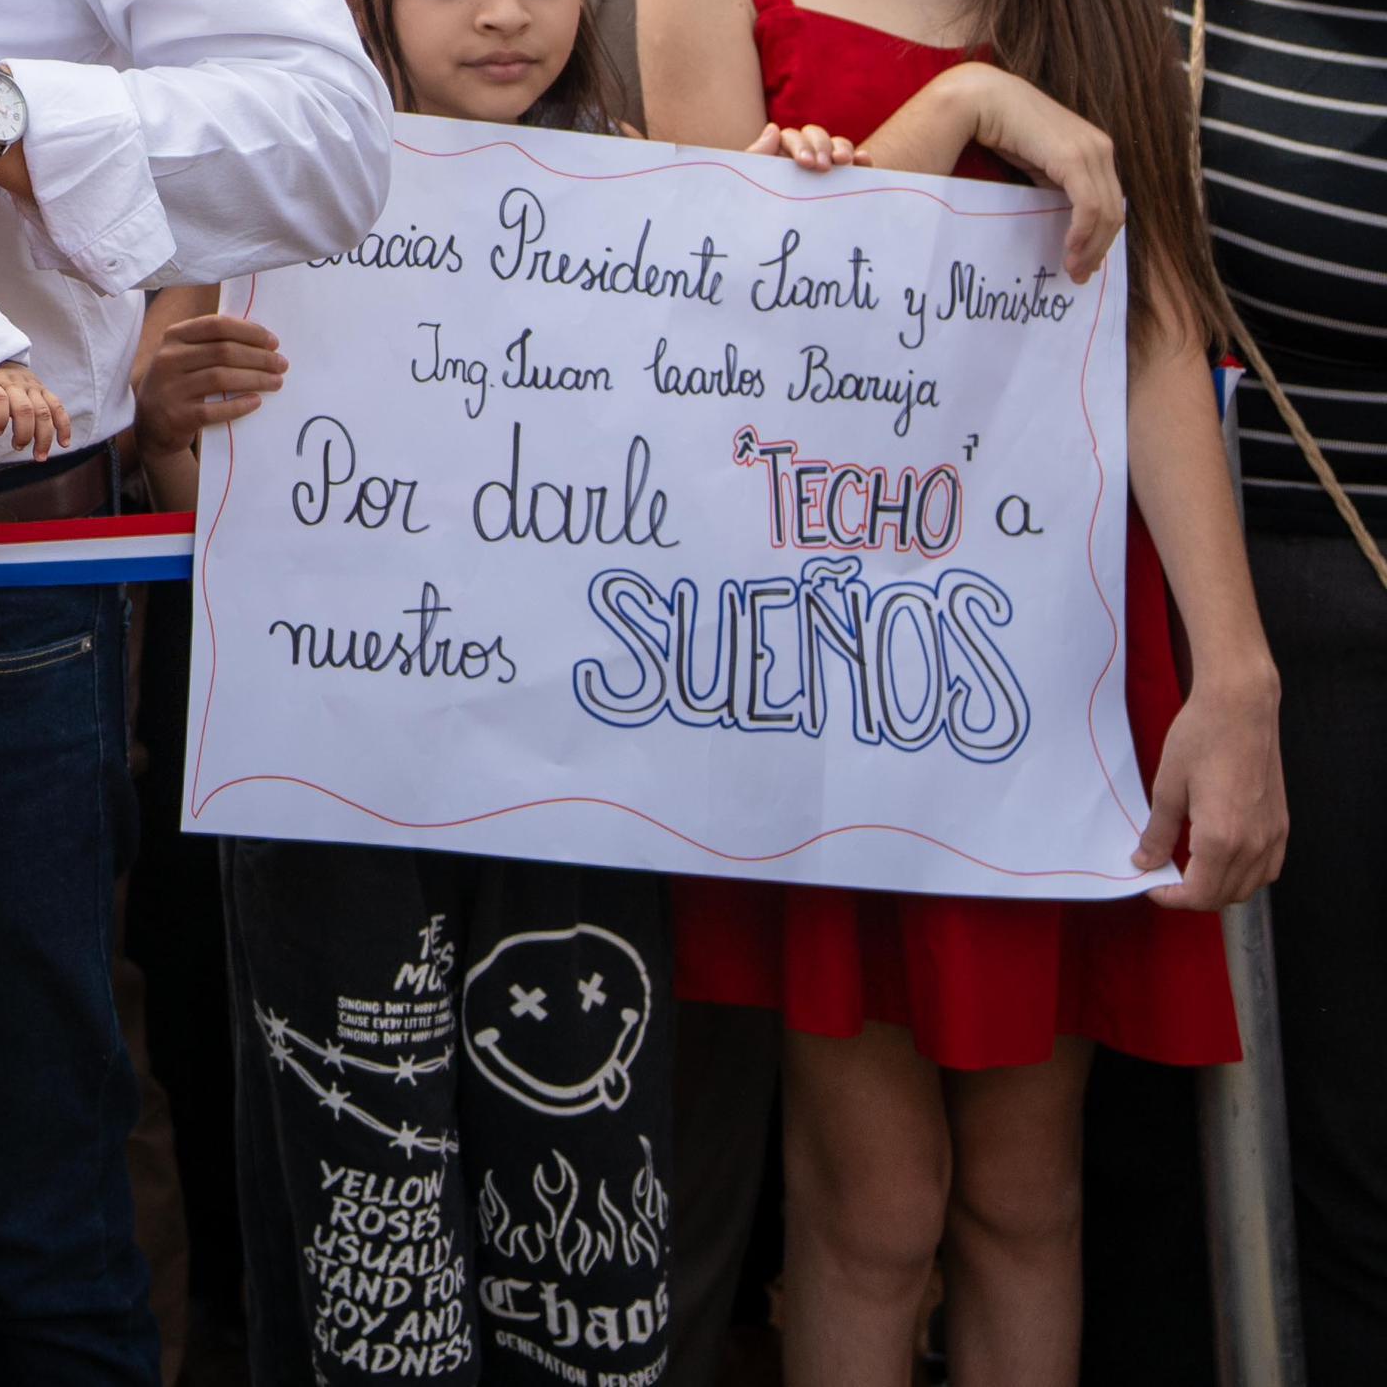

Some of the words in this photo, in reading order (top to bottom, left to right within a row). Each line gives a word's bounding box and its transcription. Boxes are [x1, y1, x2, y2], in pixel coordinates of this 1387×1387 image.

[490, 187, 728, 305] Presidente
[752, 229, 879, 311] Santi
[899, 286, 927, 349] y
[936, 261, 1074, 324] Ministro
[787, 345, 940, 437] Baruja
[292, 415, 430, 533] Por
[473, 421, 680, 548] darle
[996, 495, 1044, 537] a
[269, 581, 516, 684] nuestros
[573, 556, 1030, 764] SUEÑOS
[321, 1160, 445, 1207] YELLOW
[314, 1224, 454, 1276] USUALLY
[330, 1196, 440, 1243] ROSES
[304, 1246, 412, 1308] STAND
[424, 1255, 466, 1307] FOR
[316, 1290, 388, 1336] JOY
[394, 1299, 462, 1344] AND
[479, 1275, 669, 1351] Chaos
[314, 1317, 472, 1377] GLADNESS
[495, 1330, 587, 1386] GENERATION
